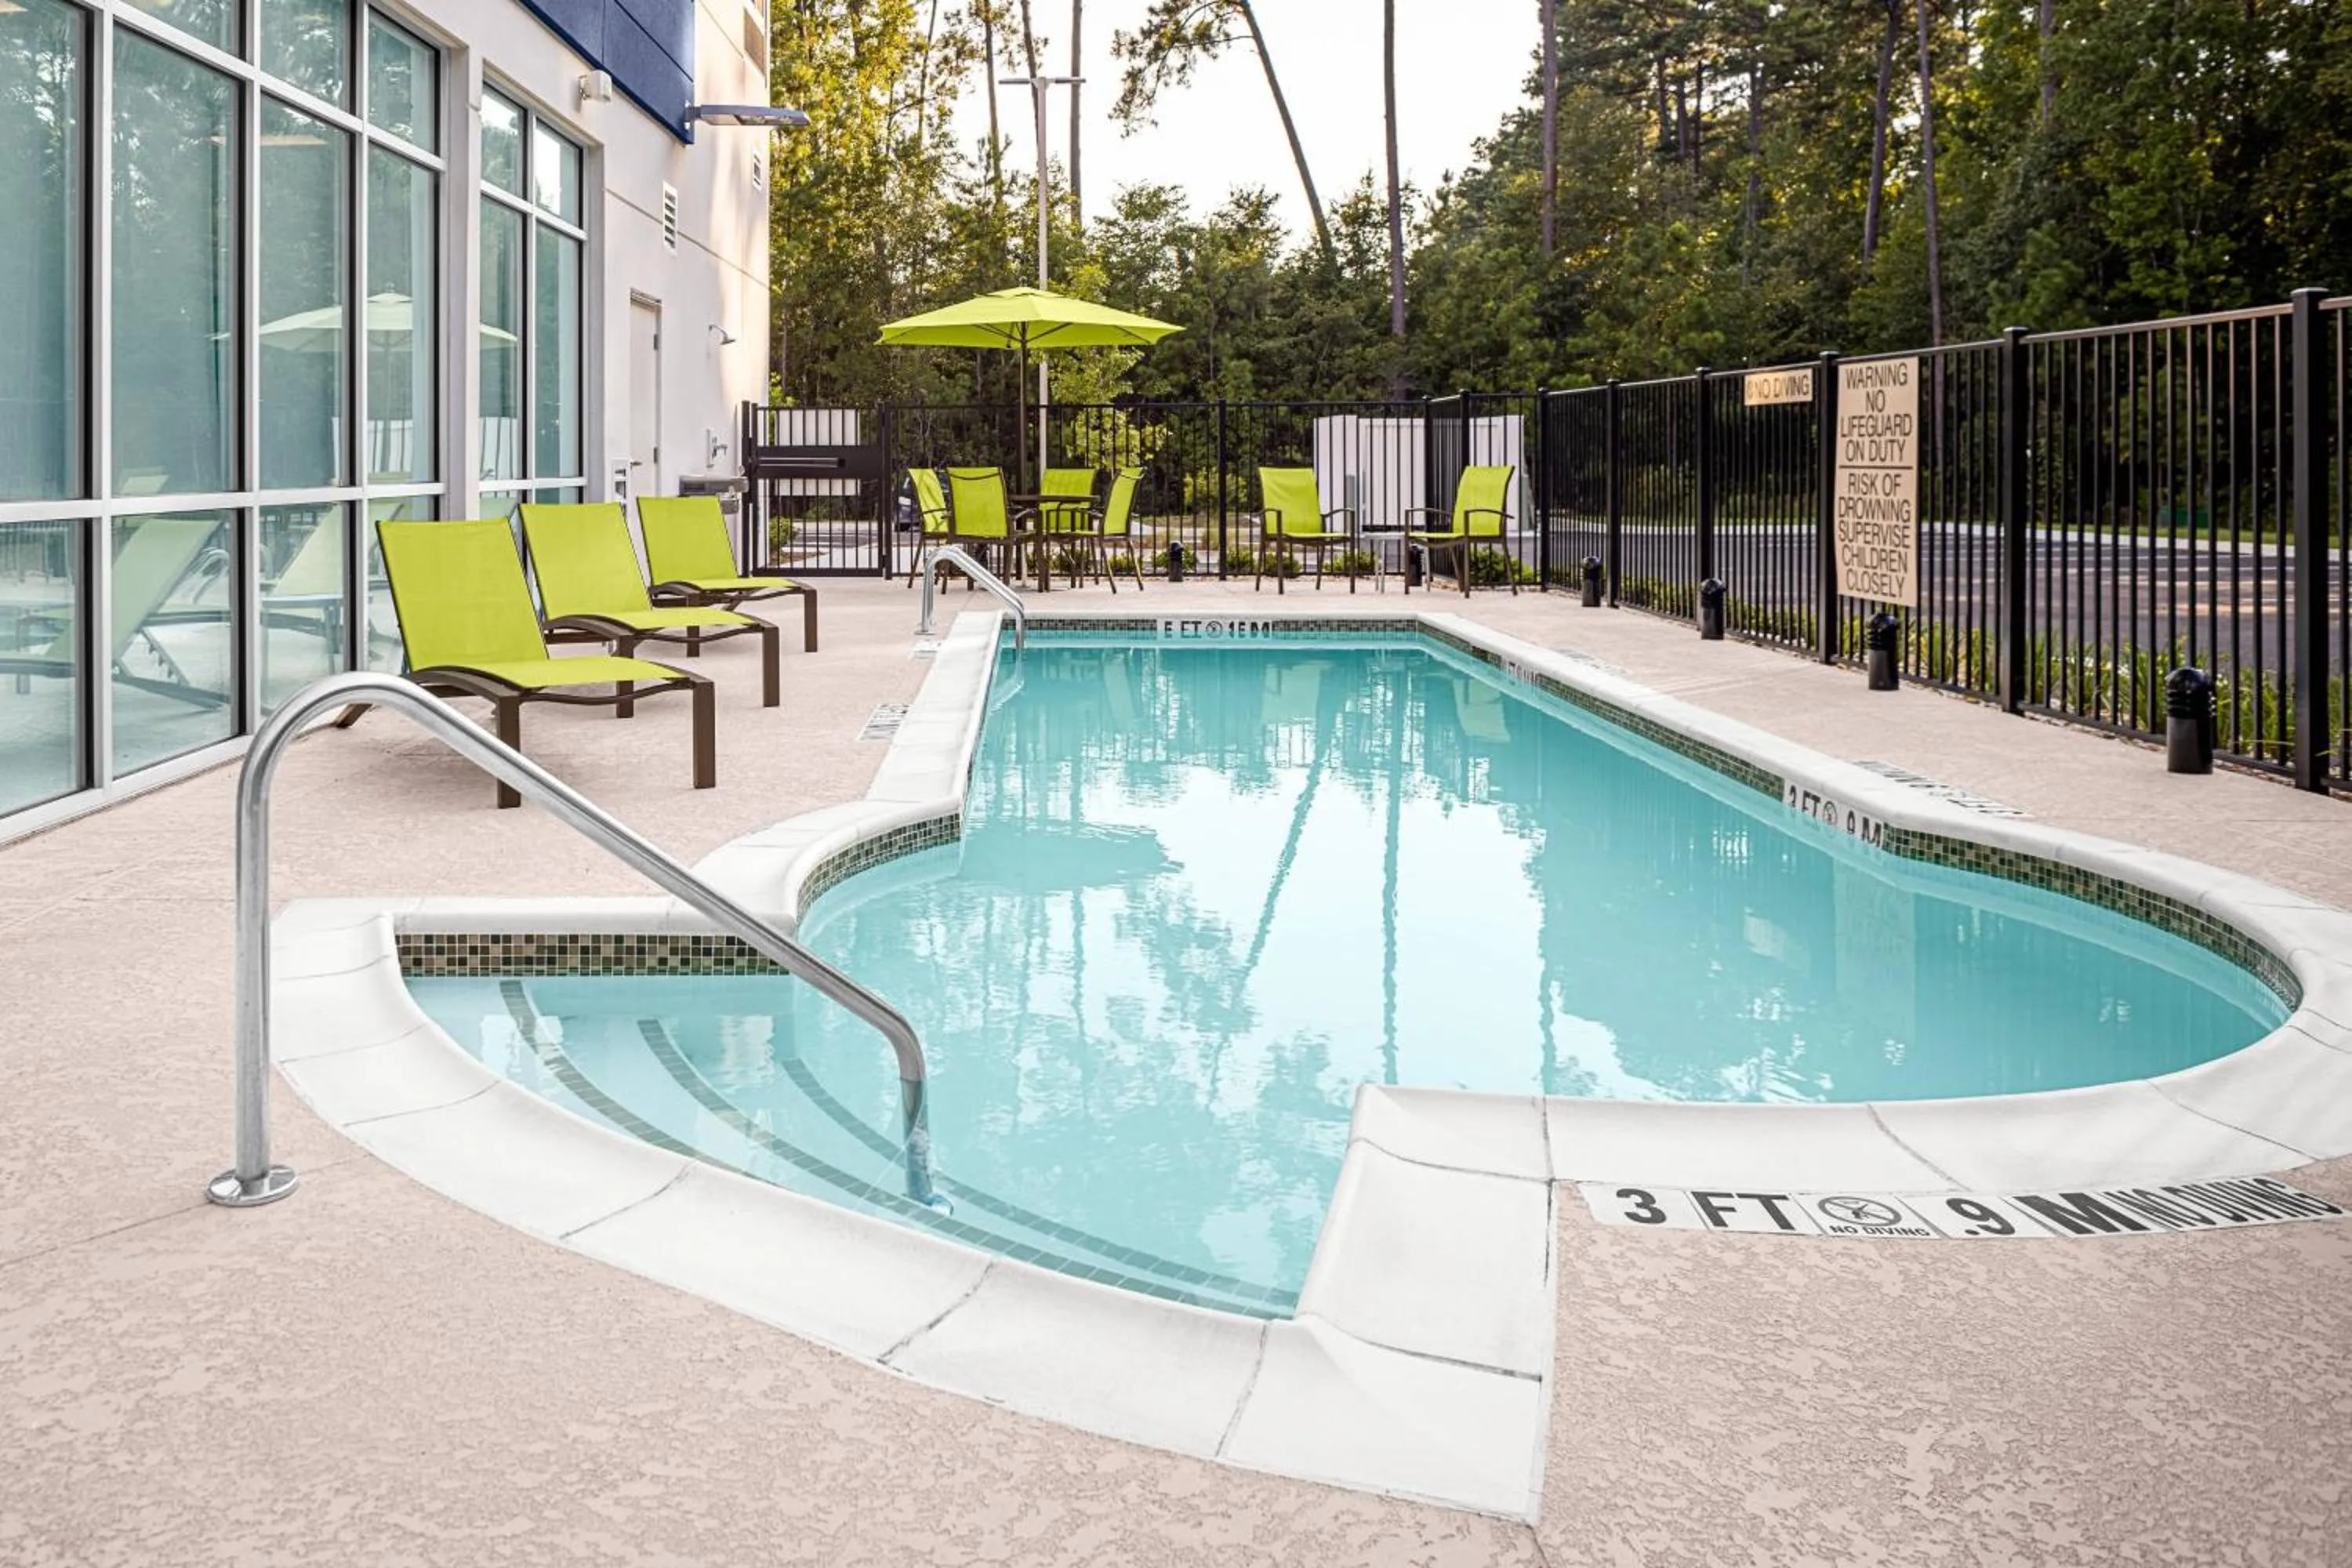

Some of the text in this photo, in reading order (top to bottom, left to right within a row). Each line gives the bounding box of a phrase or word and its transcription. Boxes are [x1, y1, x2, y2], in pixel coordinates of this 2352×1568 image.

[1755, 374, 1810, 399] NO DIVING
[1845, 362, 1907, 389] WARNING
[1866, 390, 1886, 412] NO
[1841, 413, 1912, 437] LIFEGUARD
[1846, 439, 1906, 462] ON DUTY
[1848, 473, 1902, 496] RISK OF
[1838, 496, 1911, 523] DROWNING
[1838, 520, 1911, 549] SUPERVISE
[1842, 544, 1907, 574] CHILDREN
[1846, 568, 1905, 598] CLOSELY
[1616, 1188, 1667, 1225] 3
[1690, 1191, 1796, 1231] FT
[2013, 1192, 2151, 1235] M
[2102, 1189, 2217, 1228] NO
[2160, 1178, 2343, 1221] DIVING
[1829, 1225, 1931, 1237] NO DIVING
